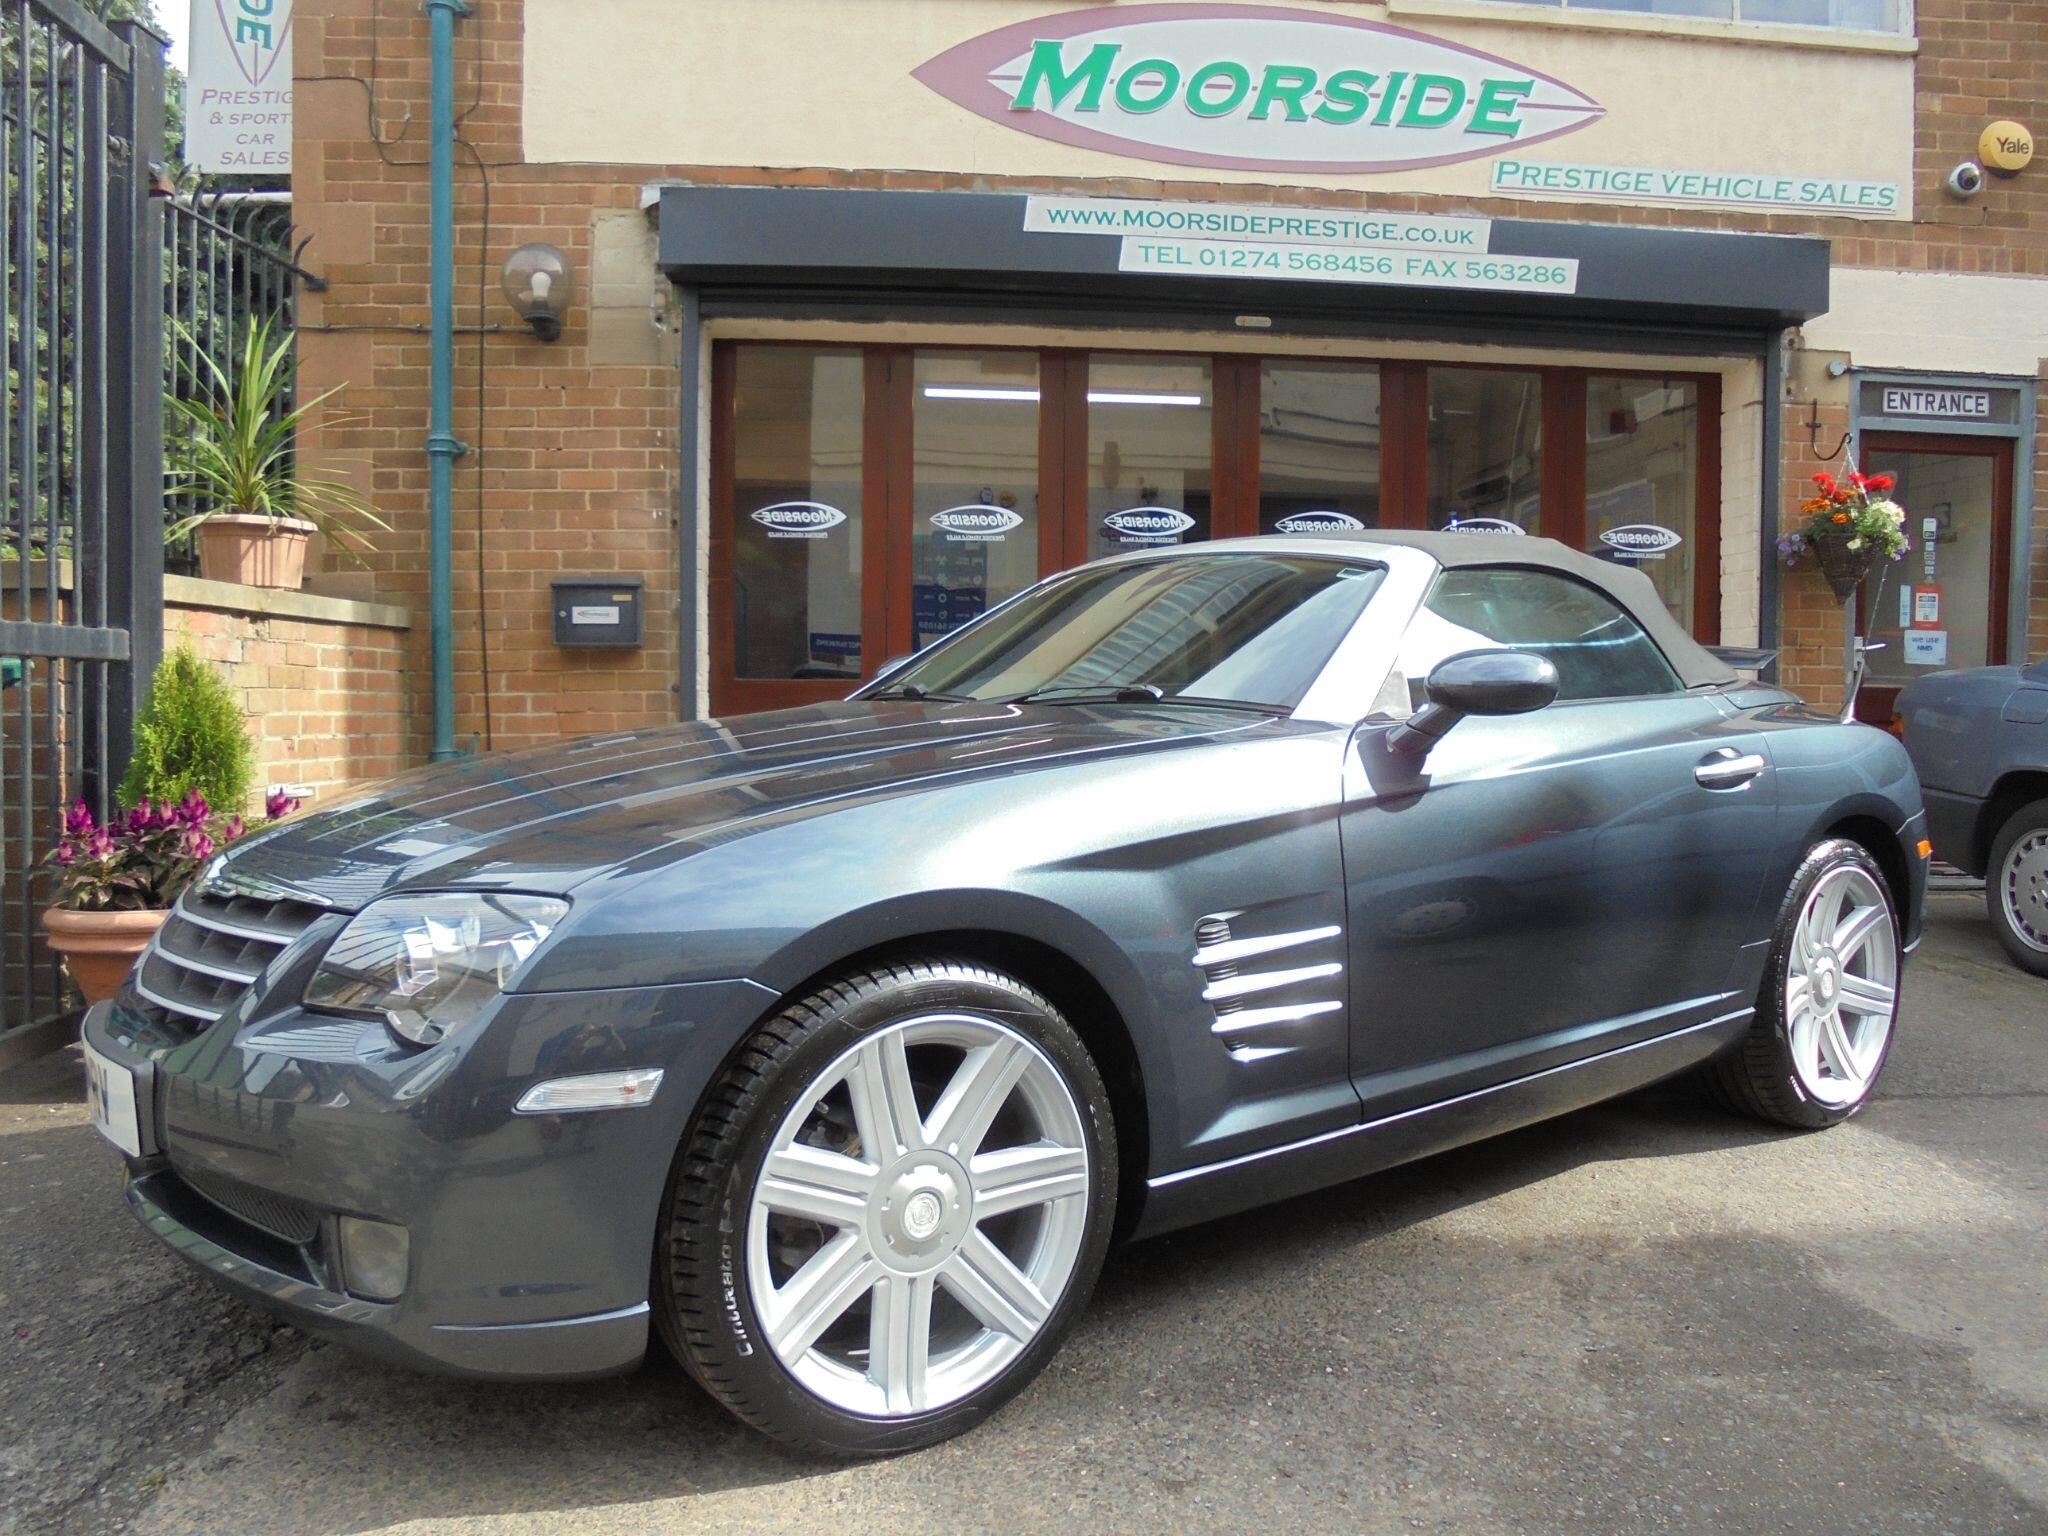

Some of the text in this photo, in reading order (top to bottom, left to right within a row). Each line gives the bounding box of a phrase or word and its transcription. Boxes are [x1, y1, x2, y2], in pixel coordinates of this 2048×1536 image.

[200, 89, 293, 105] PRESTIG
[1009, 39, 1535, 138] MOORSIDE
[209, 111, 293, 125] & SPORT
[236, 133, 276, 145] CAR
[1996, 137, 2029, 154] Yale
[220, 151, 290, 165] SALES
[1496, 161, 1895, 207] PRESTIGE VEHICLE SALES
[1138, 245, 1567, 284] TEL 01274 568456 FAX 563286
[1887, 391, 1986, 414] ENTRANCE
